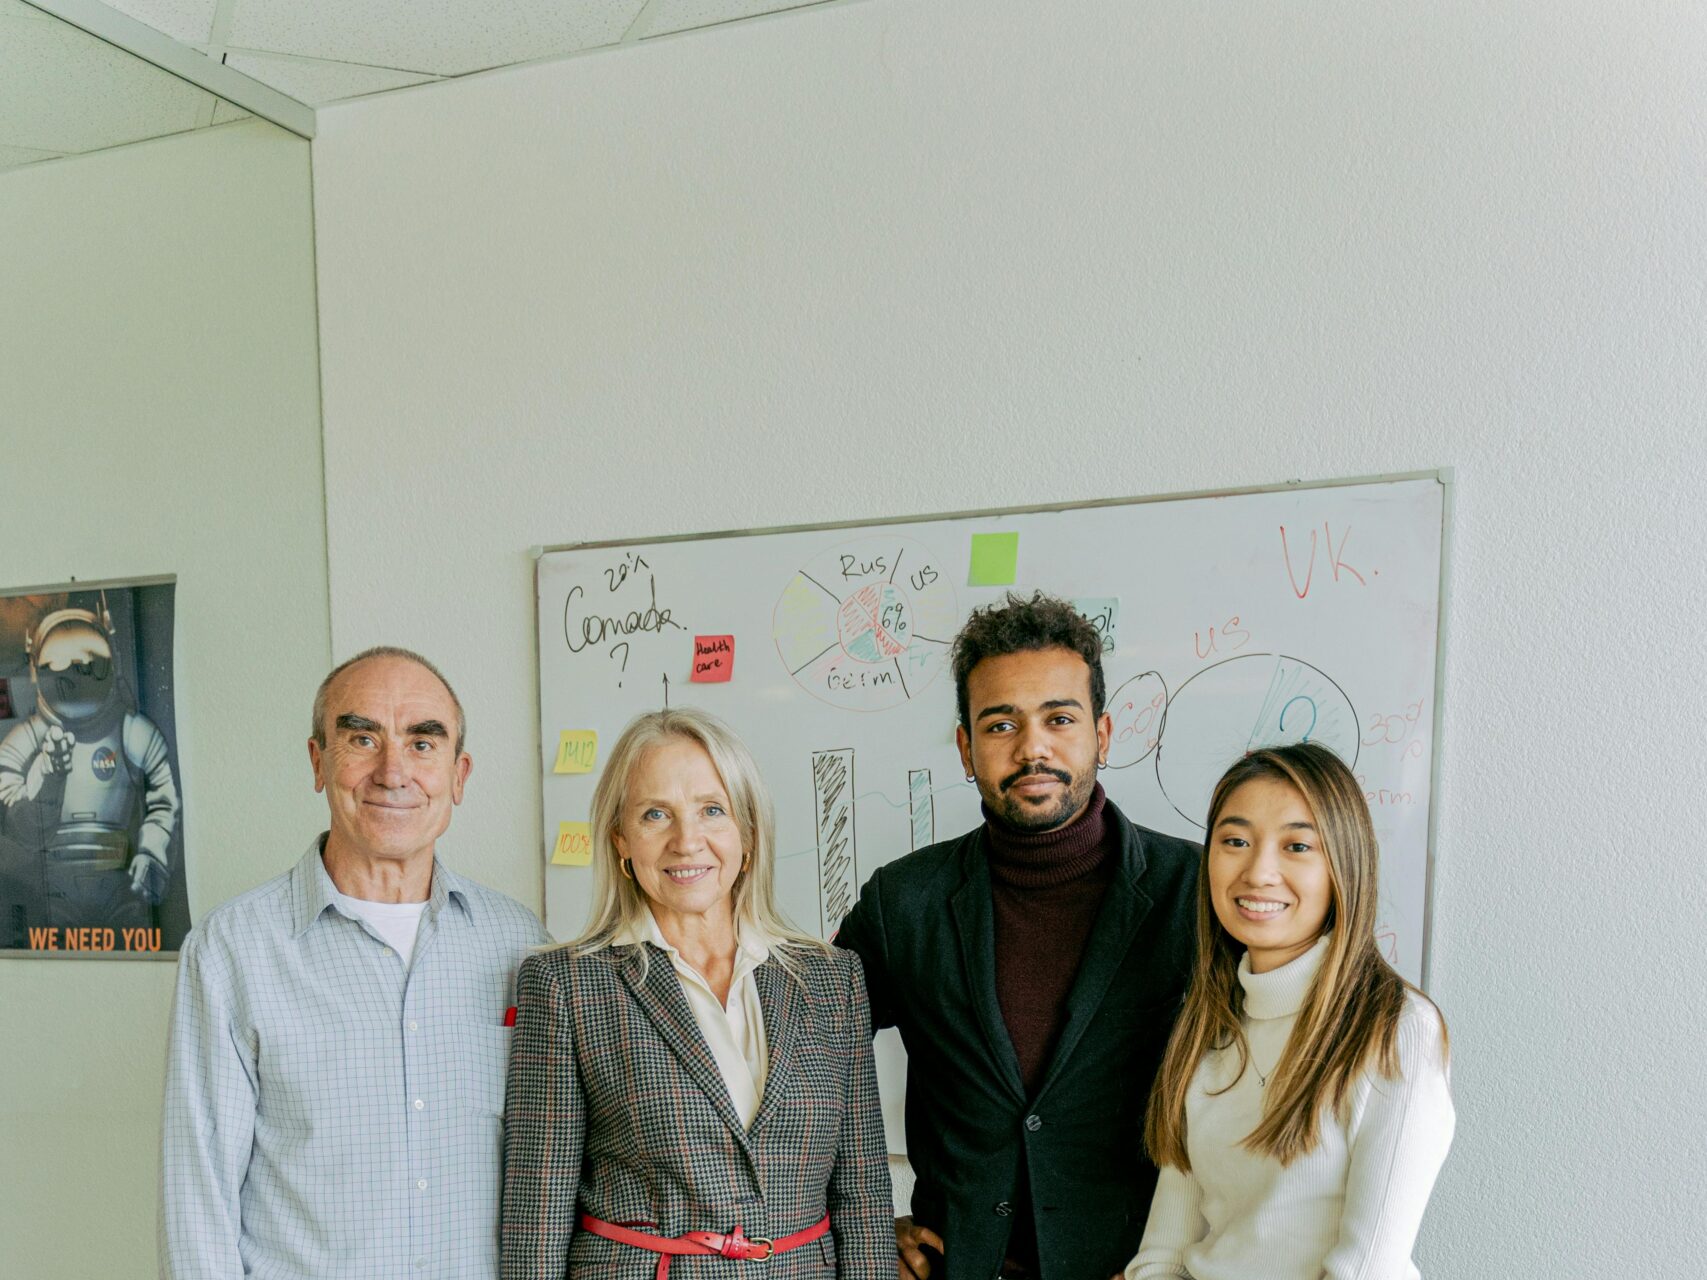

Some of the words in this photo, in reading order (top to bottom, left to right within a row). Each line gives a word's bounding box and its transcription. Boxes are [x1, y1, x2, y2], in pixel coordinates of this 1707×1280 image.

[881, 602, 907, 633] 6%
[696, 639, 731, 656] Health
[609, 642, 629, 689] ?
[696, 658, 723, 674] care
[93, 759, 116, 769] NASA
[29, 927, 59, 950] WE
[65, 927, 115, 951] NEED
[122, 927, 161, 951] YOU
